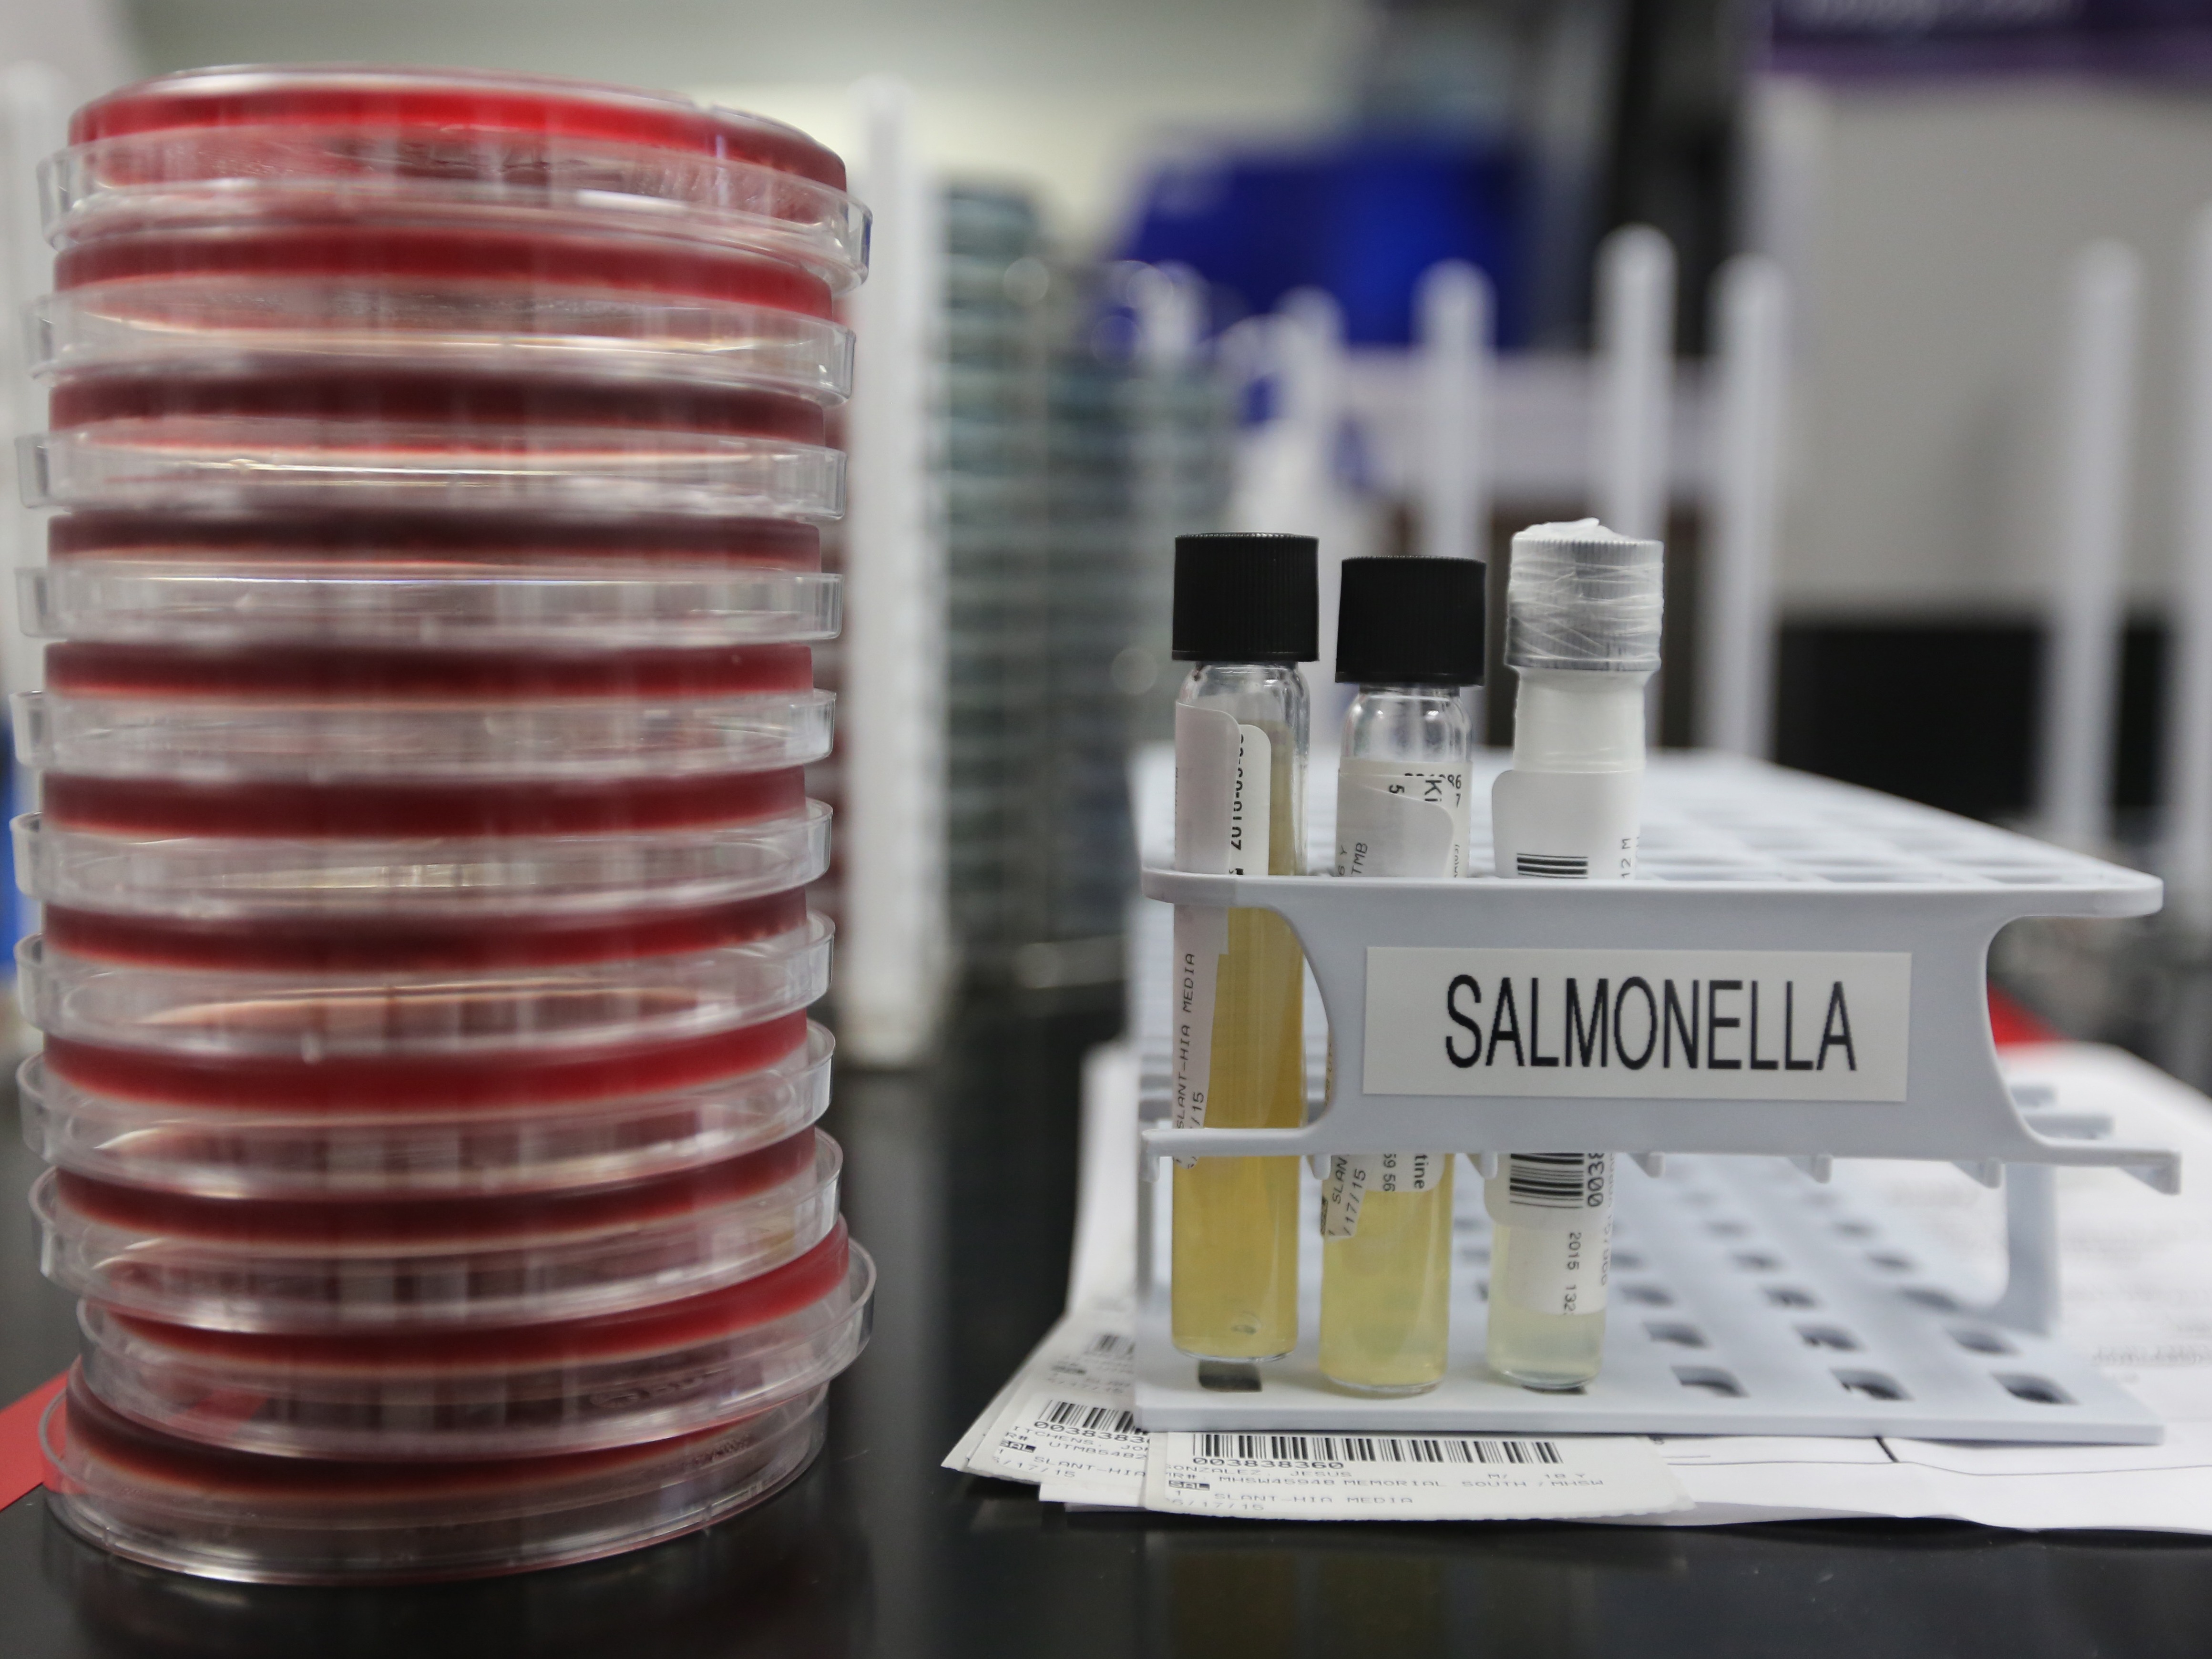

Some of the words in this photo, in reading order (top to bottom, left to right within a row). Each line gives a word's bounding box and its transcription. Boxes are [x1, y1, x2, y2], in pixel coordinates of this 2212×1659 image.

[1183, 953, 1195, 1014] MEDIA
[1445, 974, 1857, 1071] SALMONELLA
[1177, 1025, 1191, 1128] SLANT-HIA
[1332, 1154, 1350, 1204] SLAN
[1383, 1174, 1396, 1192] 56
[1414, 1154, 1429, 1189] tine
[1567, 1232, 1582, 1270] 2015
[1564, 1285, 1577, 1315] 132
[1034, 1421, 1149, 1444] 0038383
[1193, 1457, 1344, 1470] 003838360
[1214, 1494, 1332, 1503] SLANT-HIA
